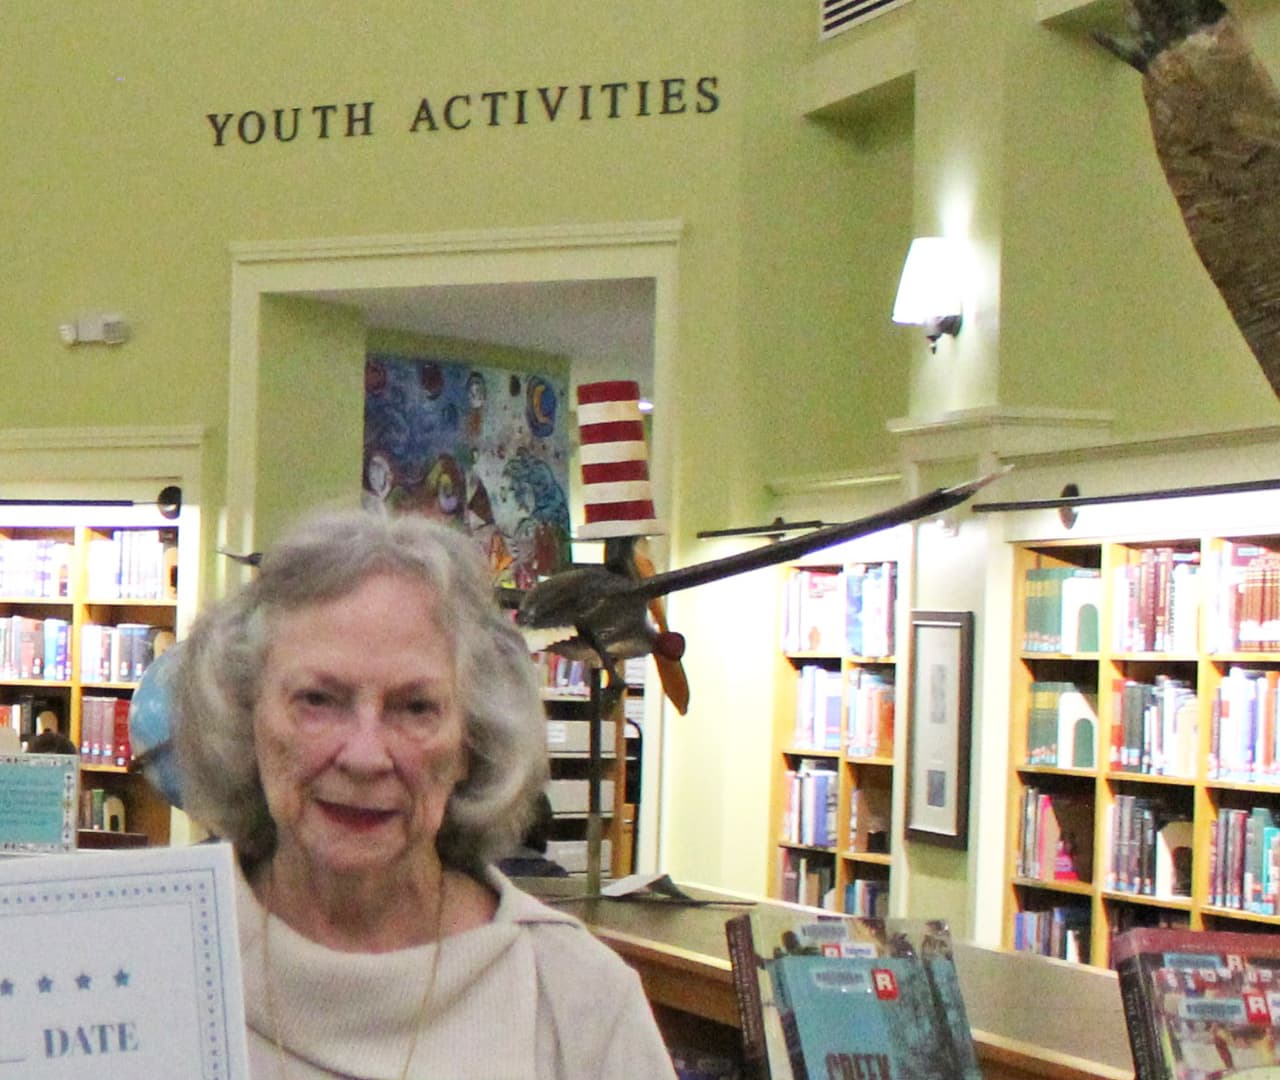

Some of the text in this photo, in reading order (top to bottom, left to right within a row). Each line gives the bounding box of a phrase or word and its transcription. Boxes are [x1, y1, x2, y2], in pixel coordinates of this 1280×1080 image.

[207, 76, 721, 147] YOUTH ACTIVITIES
[877, 973, 892, 990] R
[1248, 997, 1266, 1014] R
[42, 1022, 139, 1059] DATE
